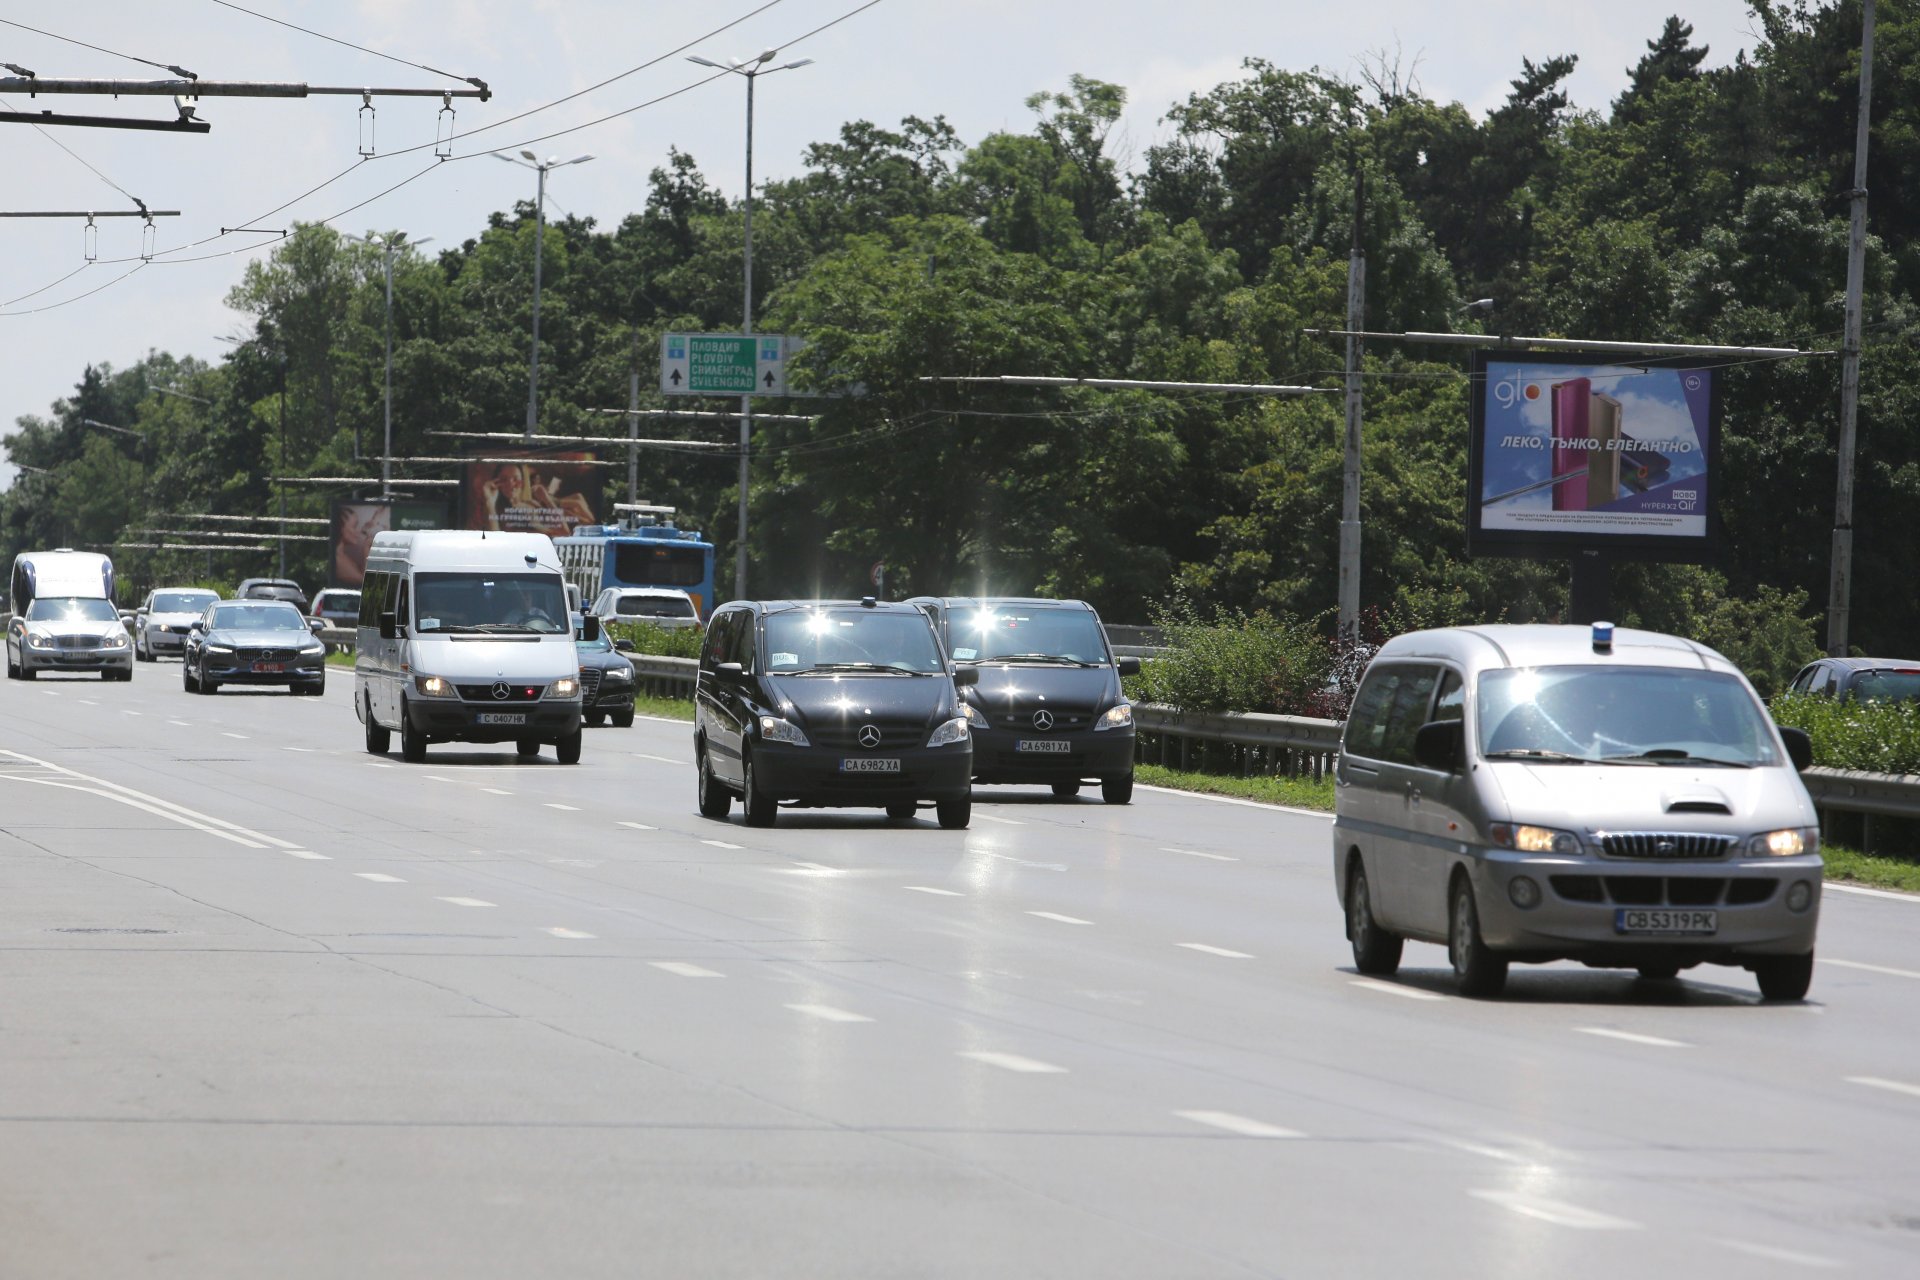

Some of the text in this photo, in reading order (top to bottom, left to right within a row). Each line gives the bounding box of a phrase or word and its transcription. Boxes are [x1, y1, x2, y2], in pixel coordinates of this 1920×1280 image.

[691, 341, 740, 352] ПЛОВДИВ
[691, 353, 734, 363] PLOVDIV
[691, 365, 754, 377] СВИЛЕНГРАД
[691, 376, 753, 388] SVILENGRAD
[1495, 369, 1541, 409] glo
[1501, 436, 1692, 453] ЛЕКО, ТЪНКО, ЕЛЕГАНТНО
